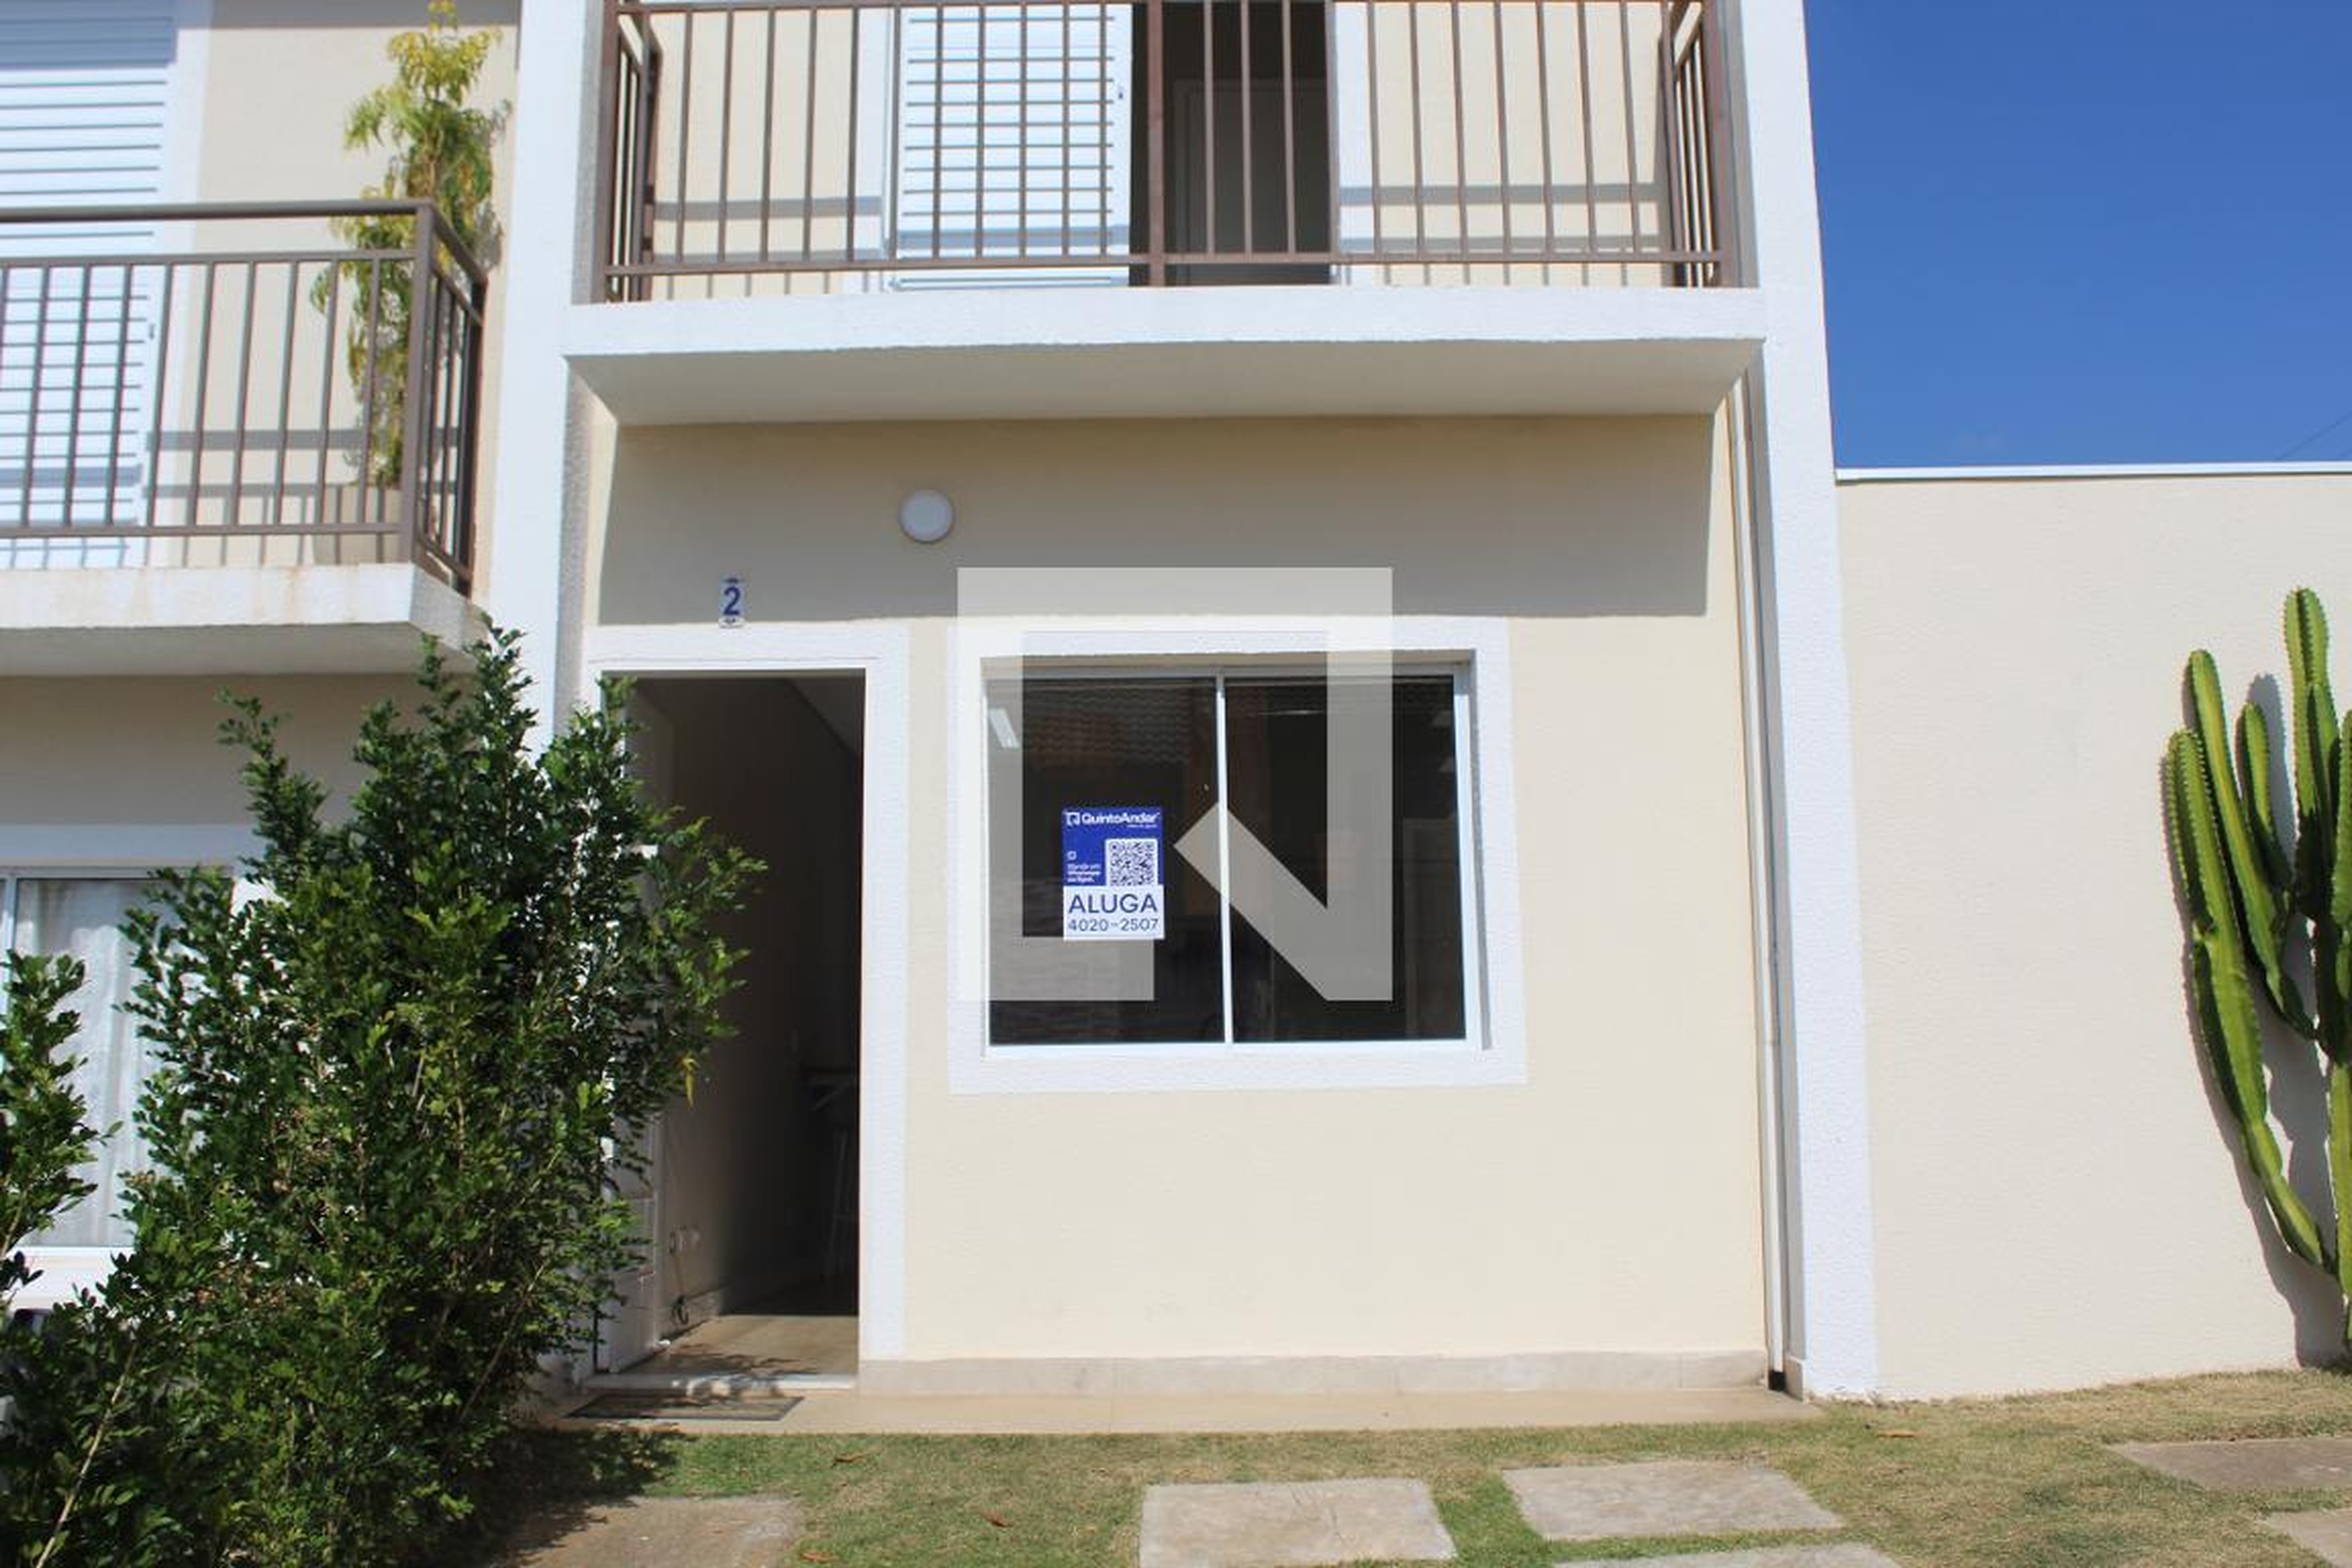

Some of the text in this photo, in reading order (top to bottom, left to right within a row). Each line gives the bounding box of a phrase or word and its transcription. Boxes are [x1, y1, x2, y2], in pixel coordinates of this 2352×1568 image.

[723, 586, 742, 616] 2
[1082, 812, 1158, 824] QuintoAndar
[1069, 894, 1157, 913] ALUGA
[1069, 918, 1159, 932] 4020-2507
